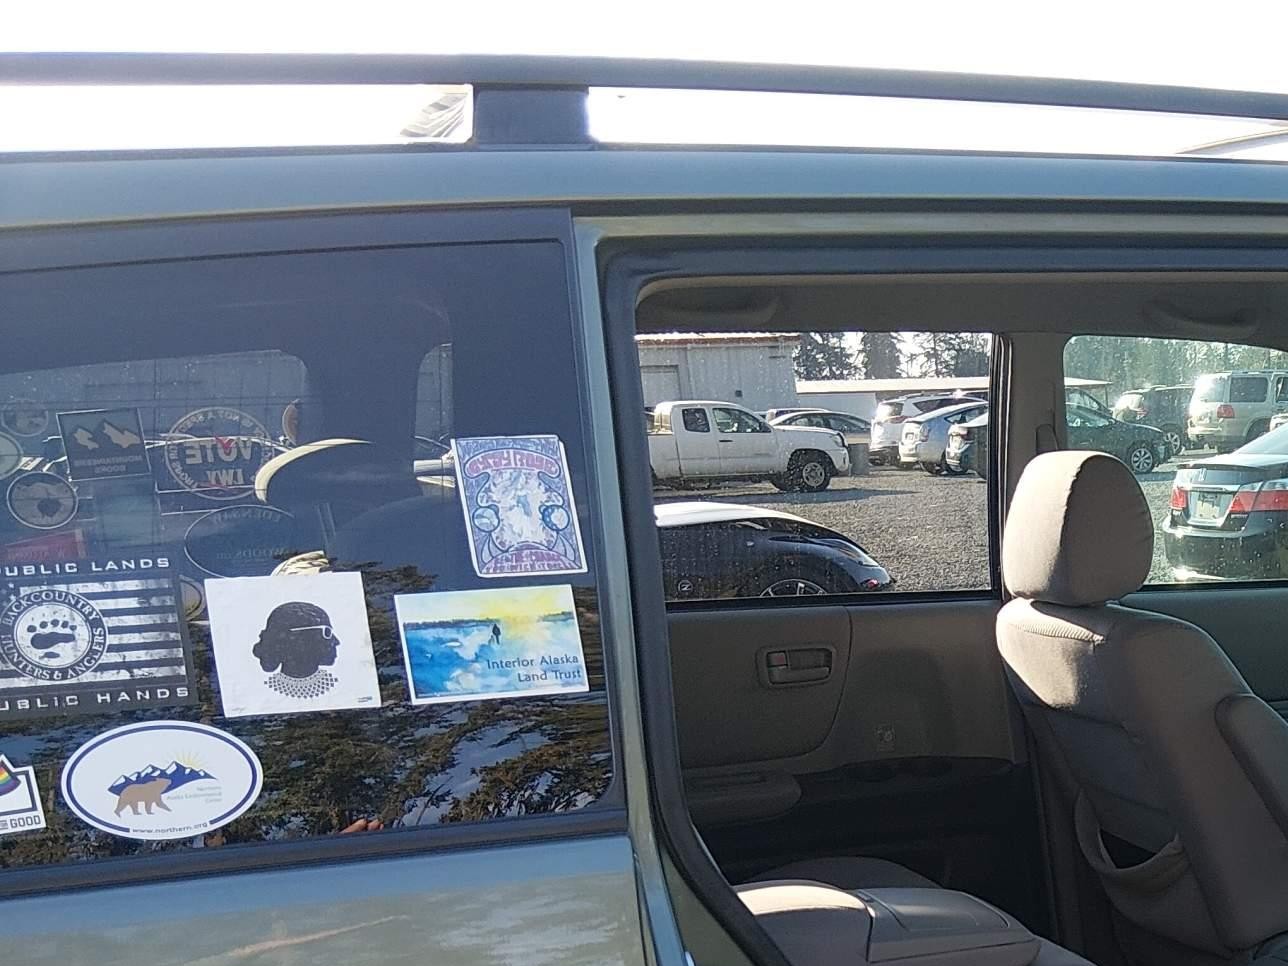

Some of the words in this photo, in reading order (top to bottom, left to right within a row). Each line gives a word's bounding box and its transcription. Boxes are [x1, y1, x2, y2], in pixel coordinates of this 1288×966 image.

[0, 562, 78, 577] UBLIC
[91, 557, 170, 572] LANDS
[2, 590, 100, 627] BACKCOUNTRY
[1, 633, 51, 681] HUNTERS
[53, 671, 62, 681] &
[66, 626, 105, 680] ANGLERS
[487, 657, 534, 670] Interior
[539, 654, 579, 666] Alaska
[518, 672, 548, 683] Land
[552, 669, 582, 681] Trust
[0, 695, 79, 711] UBLIC
[97, 687, 189, 704] HANDS
[9, 815, 42, 829] GOOD
[132, 822, 208, 834] www.northern.org
